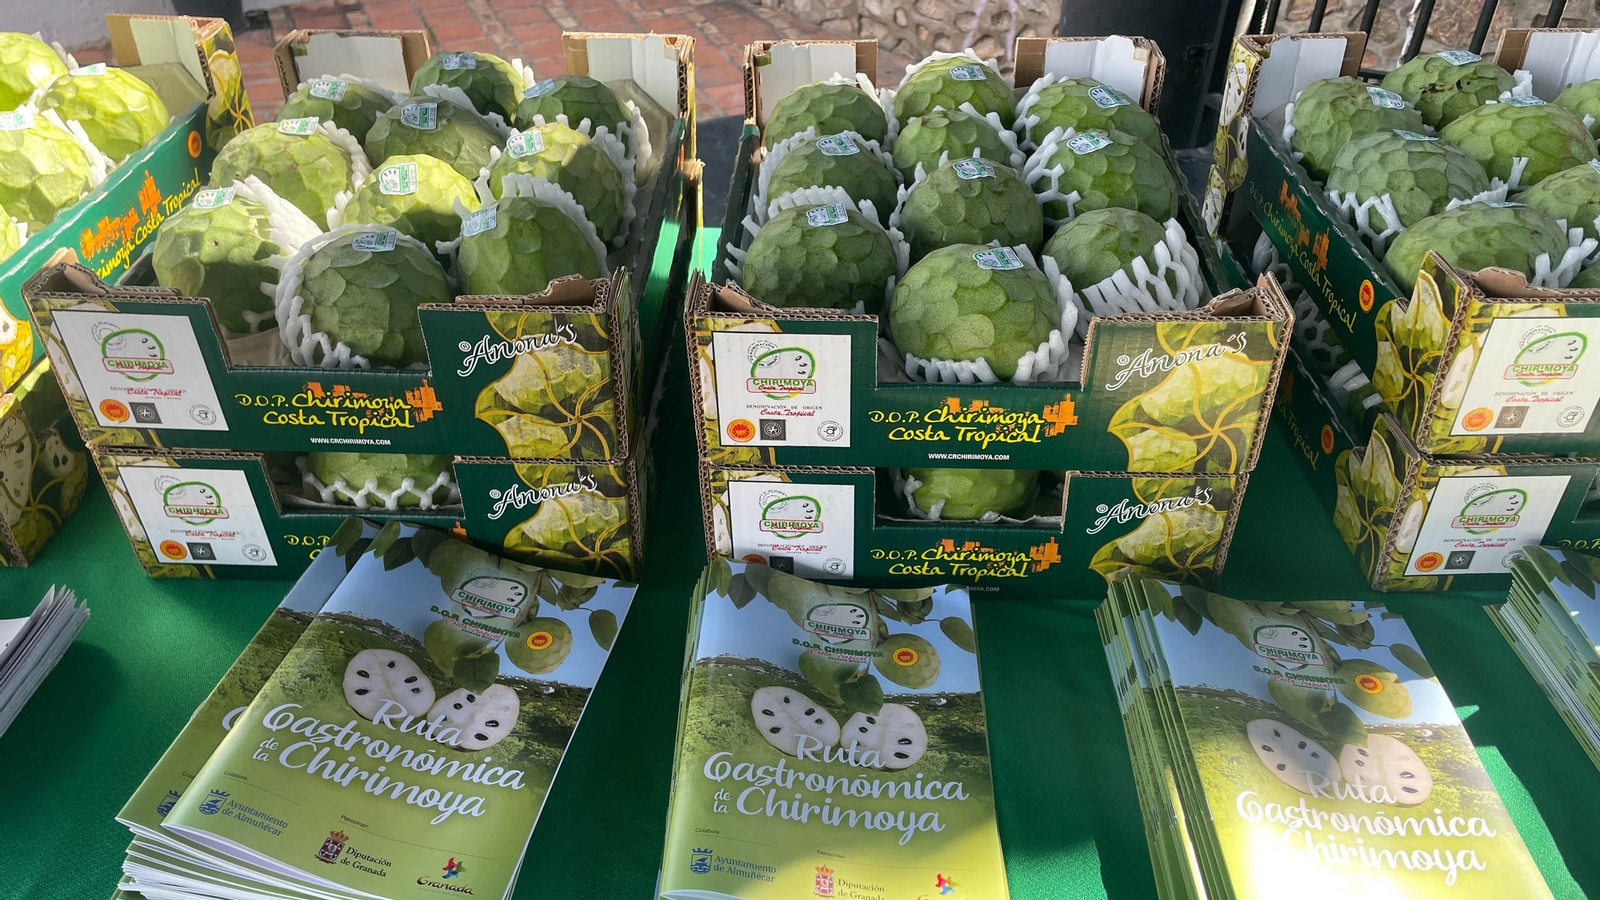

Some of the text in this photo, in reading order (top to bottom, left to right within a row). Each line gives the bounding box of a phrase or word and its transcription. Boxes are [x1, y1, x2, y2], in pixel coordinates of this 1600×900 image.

[94, 240, 135, 279] rimoya
[135, 211, 165, 245] Costa
[162, 167, 201, 216] Tropical
[1299, 251, 1321, 287] Costa
[1322, 275, 1357, 333] Tropical
[1512, 364, 1575, 373] CHIRIMOYA
[752, 378, 814, 387] CHIRIMOYA
[234, 389, 412, 418] D.O.P. Chirimoya
[760, 408, 816, 417] Costa Tropical
[263, 409, 415, 434] Costa Tropical
[868, 406, 1045, 433] D.O.P. Chirimoya
[310, 437, 391, 445] WWW.CRCHIRIMOYA.COM
[888, 424, 1041, 449] Costa Tropical
[1288, 409, 1319, 470] Tropical
[928, 453, 1010, 461] WWW.CRCHIRIMOYA.COM
[870, 545, 1031, 568] D.O.P. Chirimoya
[888, 561, 1028, 582] Costa Tropical
[458, 591, 516, 614] CHIRIMOYA
[462, 618, 520, 639] CHIRIMOYA
[808, 621, 867, 635] CHIRIMOYA
[824, 646, 885, 657] CHIRIMOYA
[1259, 645, 1319, 660] CHIRIMOYA
[1285, 672, 1347, 685] CHIRIMOYA
[372, 698, 463, 747] Ruta
[260, 737, 279, 750] de
[262, 703, 526, 790] Gastronómica
[793, 733, 886, 769] Ruta
[253, 748, 269, 762] la
[278, 741, 486, 826] Chirimoya
[703, 751, 970, 801] Gastronómica
[1300, 769, 1397, 804] Ruta
[714, 788, 731, 801] de
[226, 799, 288, 829] Ayuntamiento
[713, 800, 729, 814] la
[736, 786, 945, 846] Chirimoya
[1235, 790, 1496, 838] Gastronómica
[222, 807, 283, 837] de Almuñécar
[340, 856, 386, 877] de Granada
[346, 846, 392, 868] Diputación
[714, 855, 777, 874] Ayuntamiento
[1281, 829, 1487, 887] Chirimoya
[713, 864, 775, 883] de Almuñécar
[416, 875, 474, 896] Granada
[838, 878, 885, 893] Diputación
[838, 889, 848, 898] de
